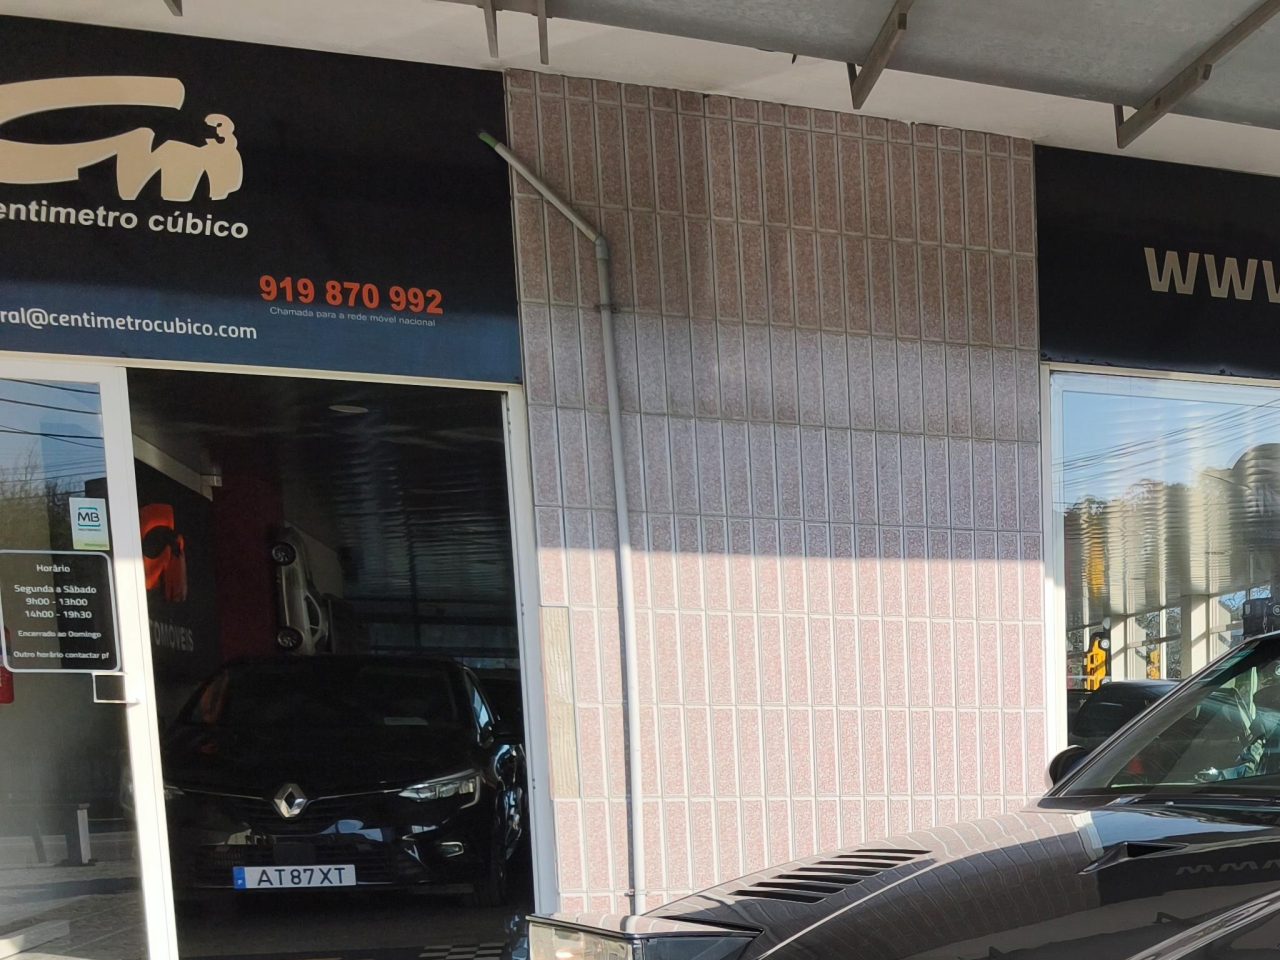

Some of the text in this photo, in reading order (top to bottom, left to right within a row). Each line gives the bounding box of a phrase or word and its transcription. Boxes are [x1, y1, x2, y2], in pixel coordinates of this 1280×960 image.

[0, 200, 248, 239] ntimetro cúbico
[259, 275, 444, 315] 919 870 992
[269, 307, 314, 318] Chamada
[316, 312, 337, 320] para
[348, 313, 367, 322] rede
[370, 314, 396, 324] móvel
[399, 317, 436, 327] nacional
[0, 307, 257, 339] ral@centimetrocubico.com
[78, 512, 100, 522] MB
[36, 564, 71, 573] Horário
[14, 584, 54, 594] Segunda
[63, 585, 97, 594] Sábado
[25, 597, 50, 606] 9h00
[59, 598, 88, 606] 13h00
[25, 610, 54, 618] 14h00
[63, 610, 92, 619] 19h30
[68, 630, 102, 639] Domingo
